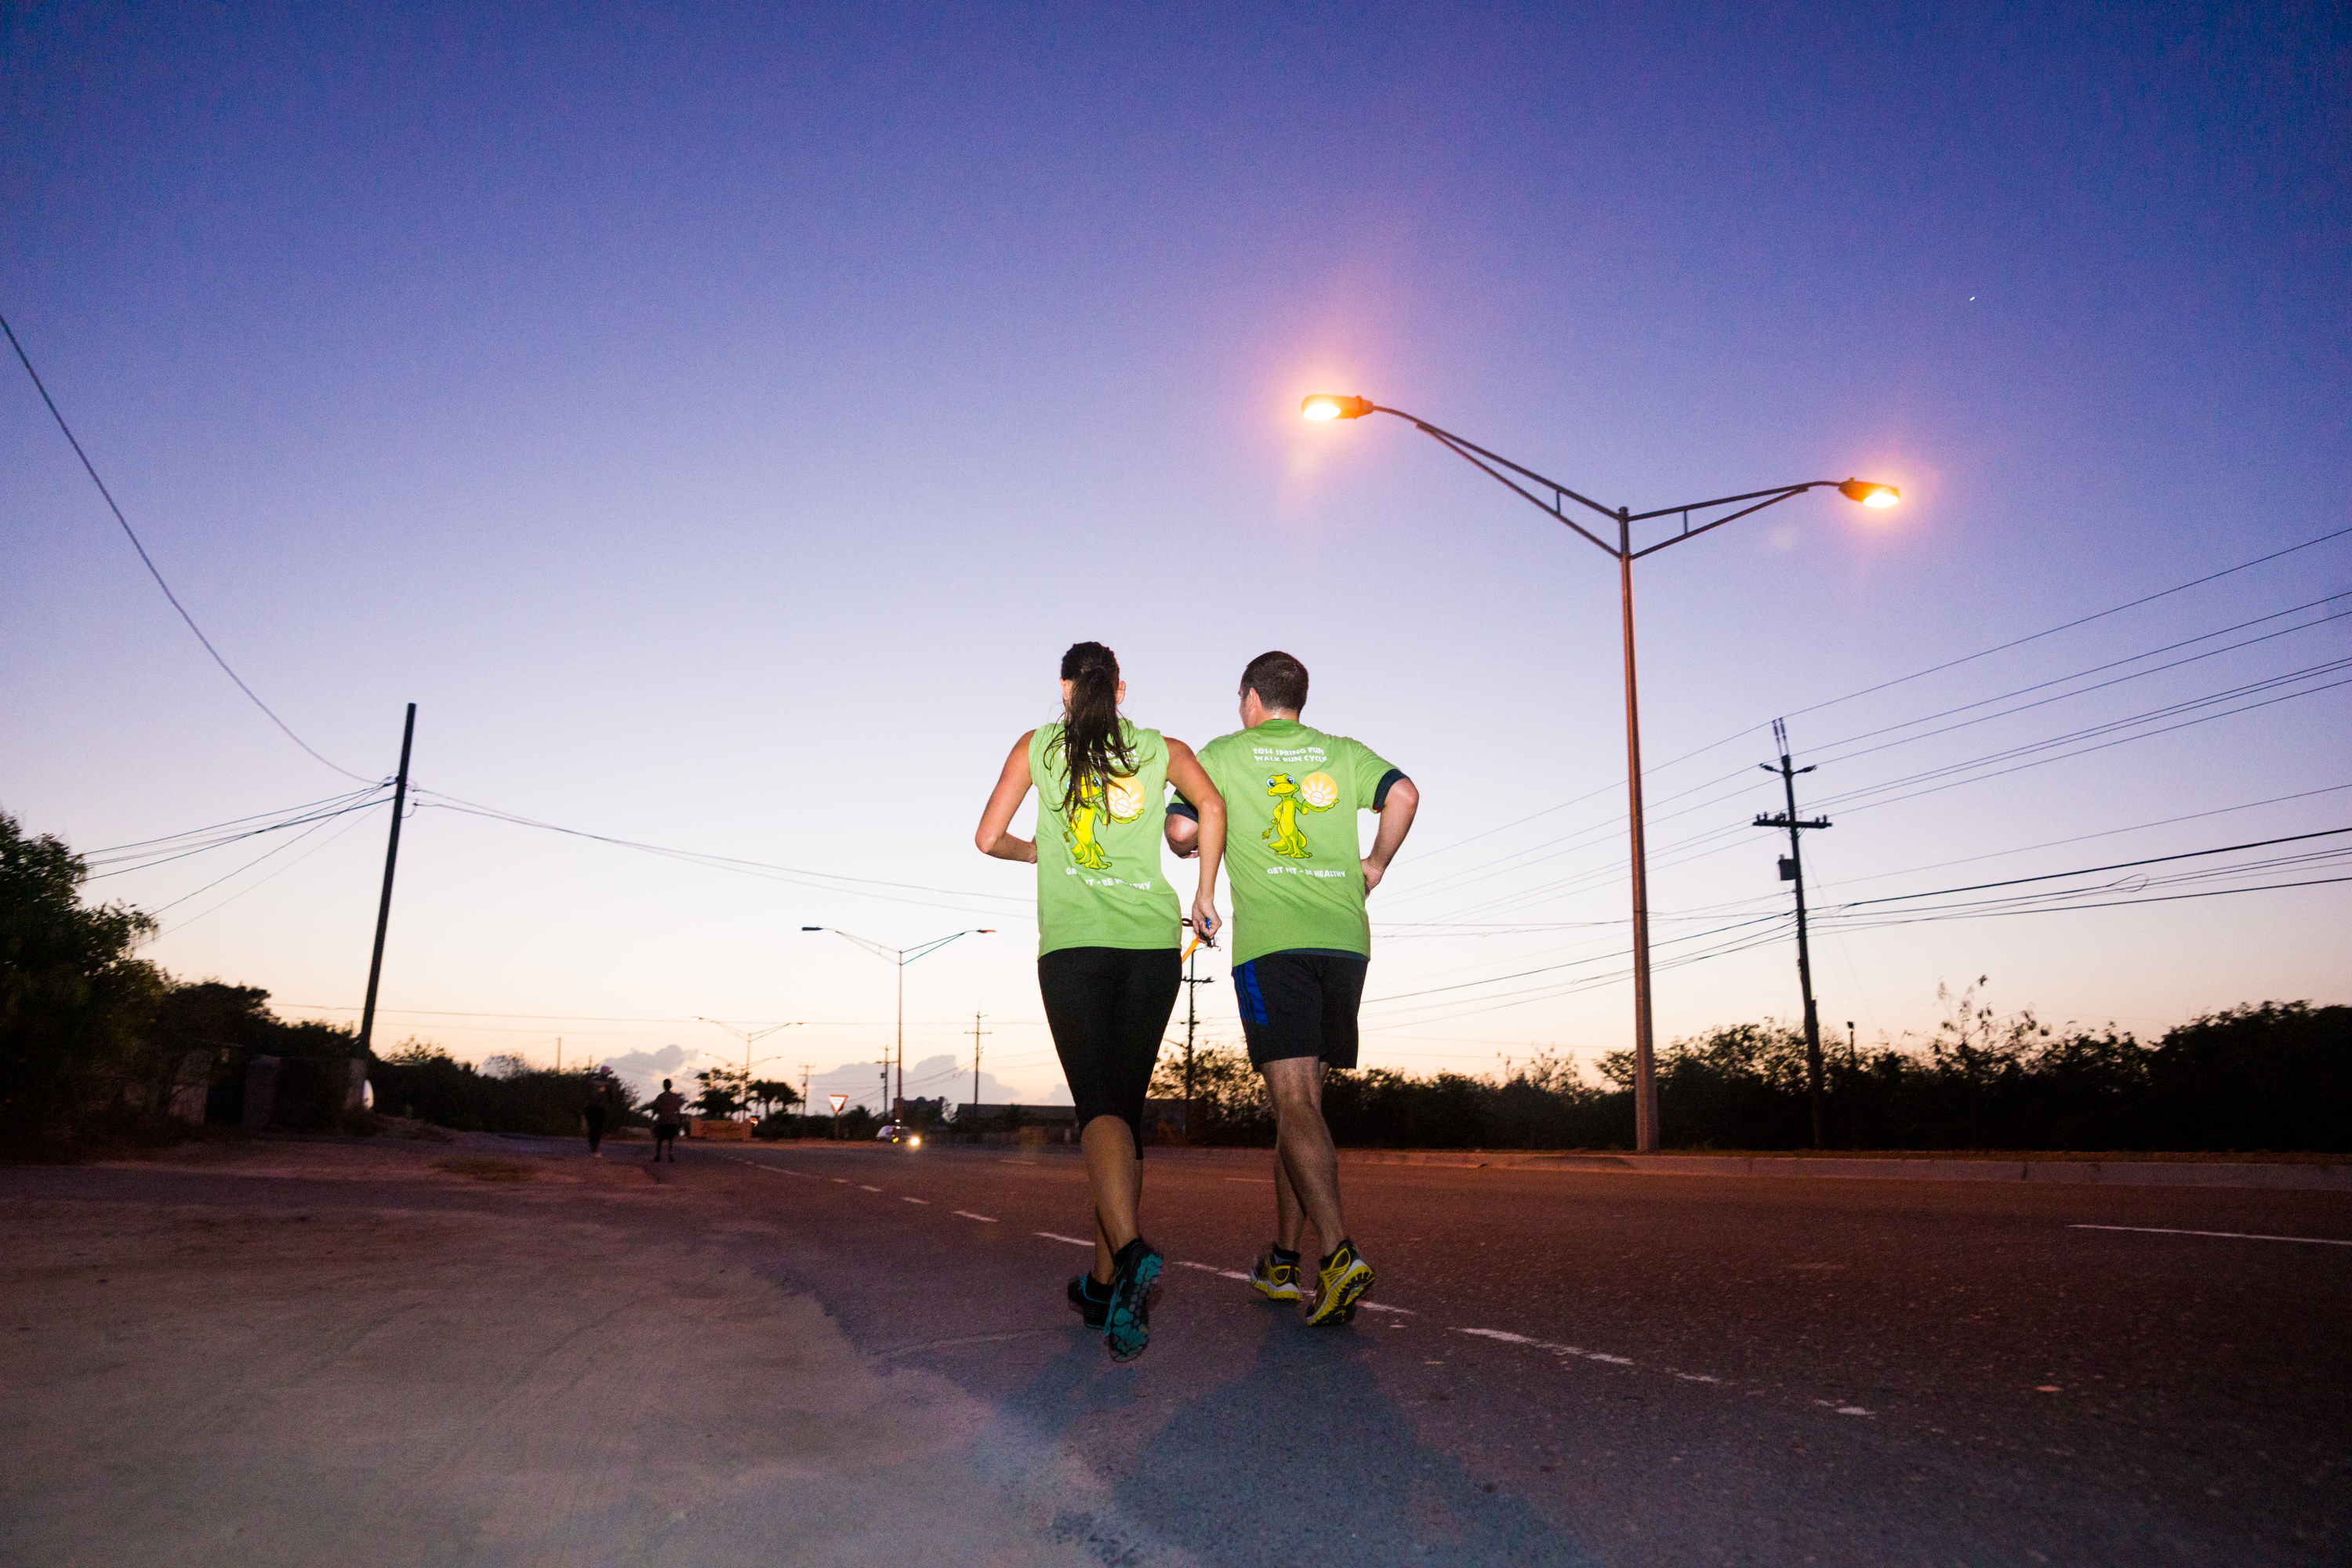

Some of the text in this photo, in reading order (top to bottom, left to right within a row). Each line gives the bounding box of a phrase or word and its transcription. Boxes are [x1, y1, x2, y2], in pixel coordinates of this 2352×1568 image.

[1307, 746, 1324, 755] FUN
[1303, 754, 1327, 763] CYCLE
[1102, 877, 1114, 886] BE
